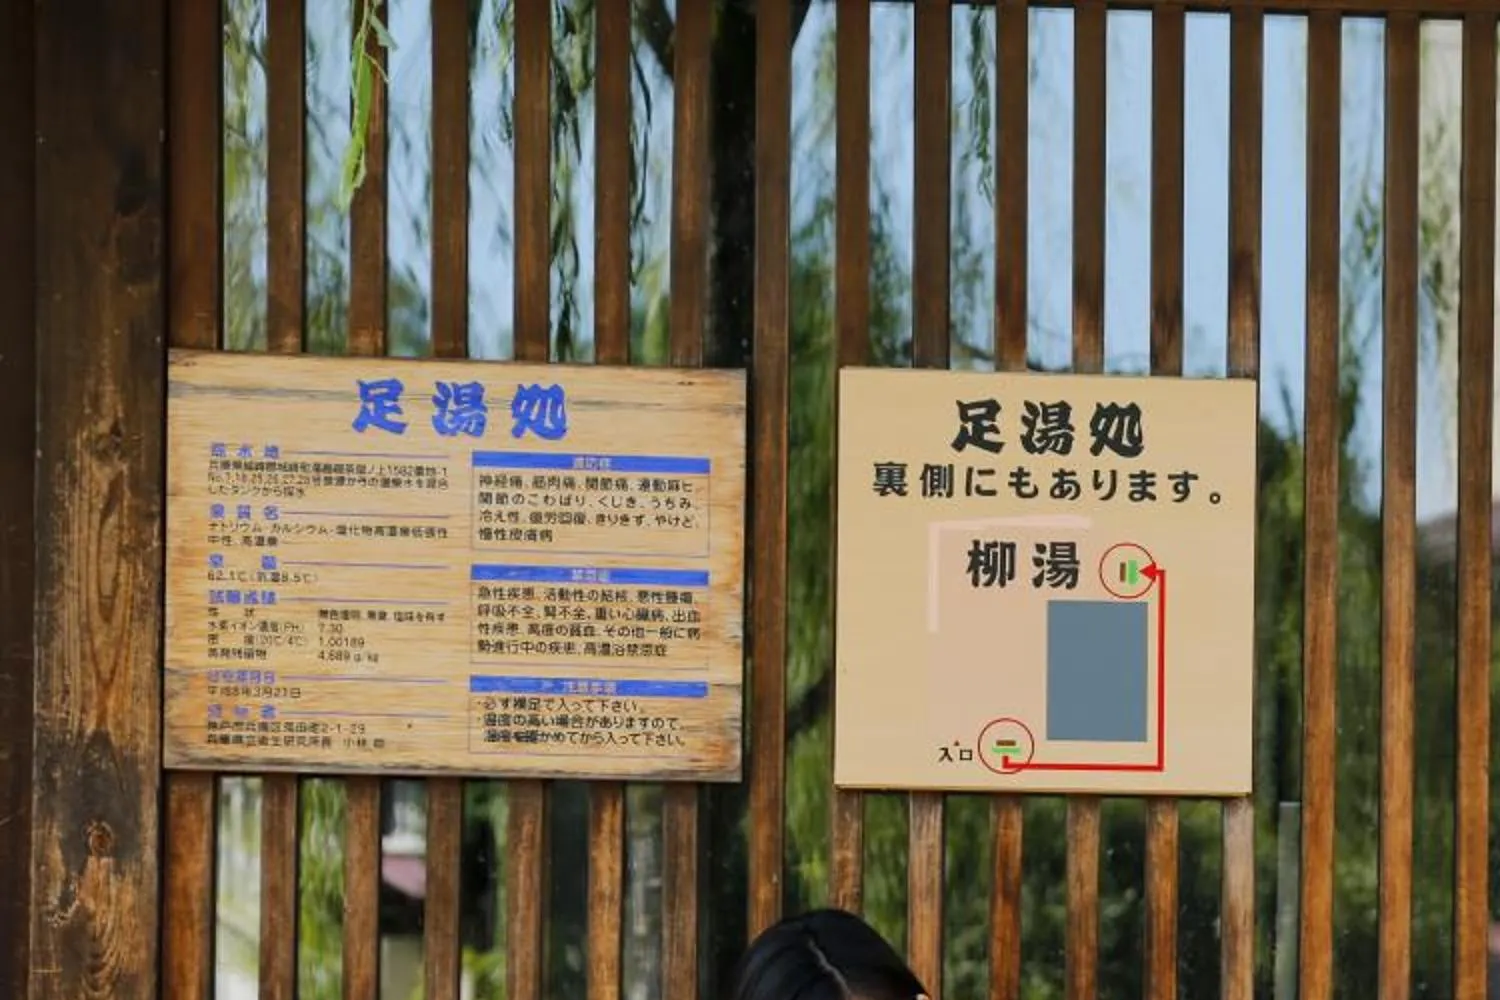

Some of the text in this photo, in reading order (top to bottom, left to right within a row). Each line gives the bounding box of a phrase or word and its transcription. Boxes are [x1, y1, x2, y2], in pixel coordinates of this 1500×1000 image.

[352, 378, 570, 441] 足湯処
[949, 397, 1145, 458] 足湯処
[872, 461, 1222, 505] 裏側にもあります。
[966, 539, 1080, 590] 柳湯
[938, 747, 974, 763] 入口
